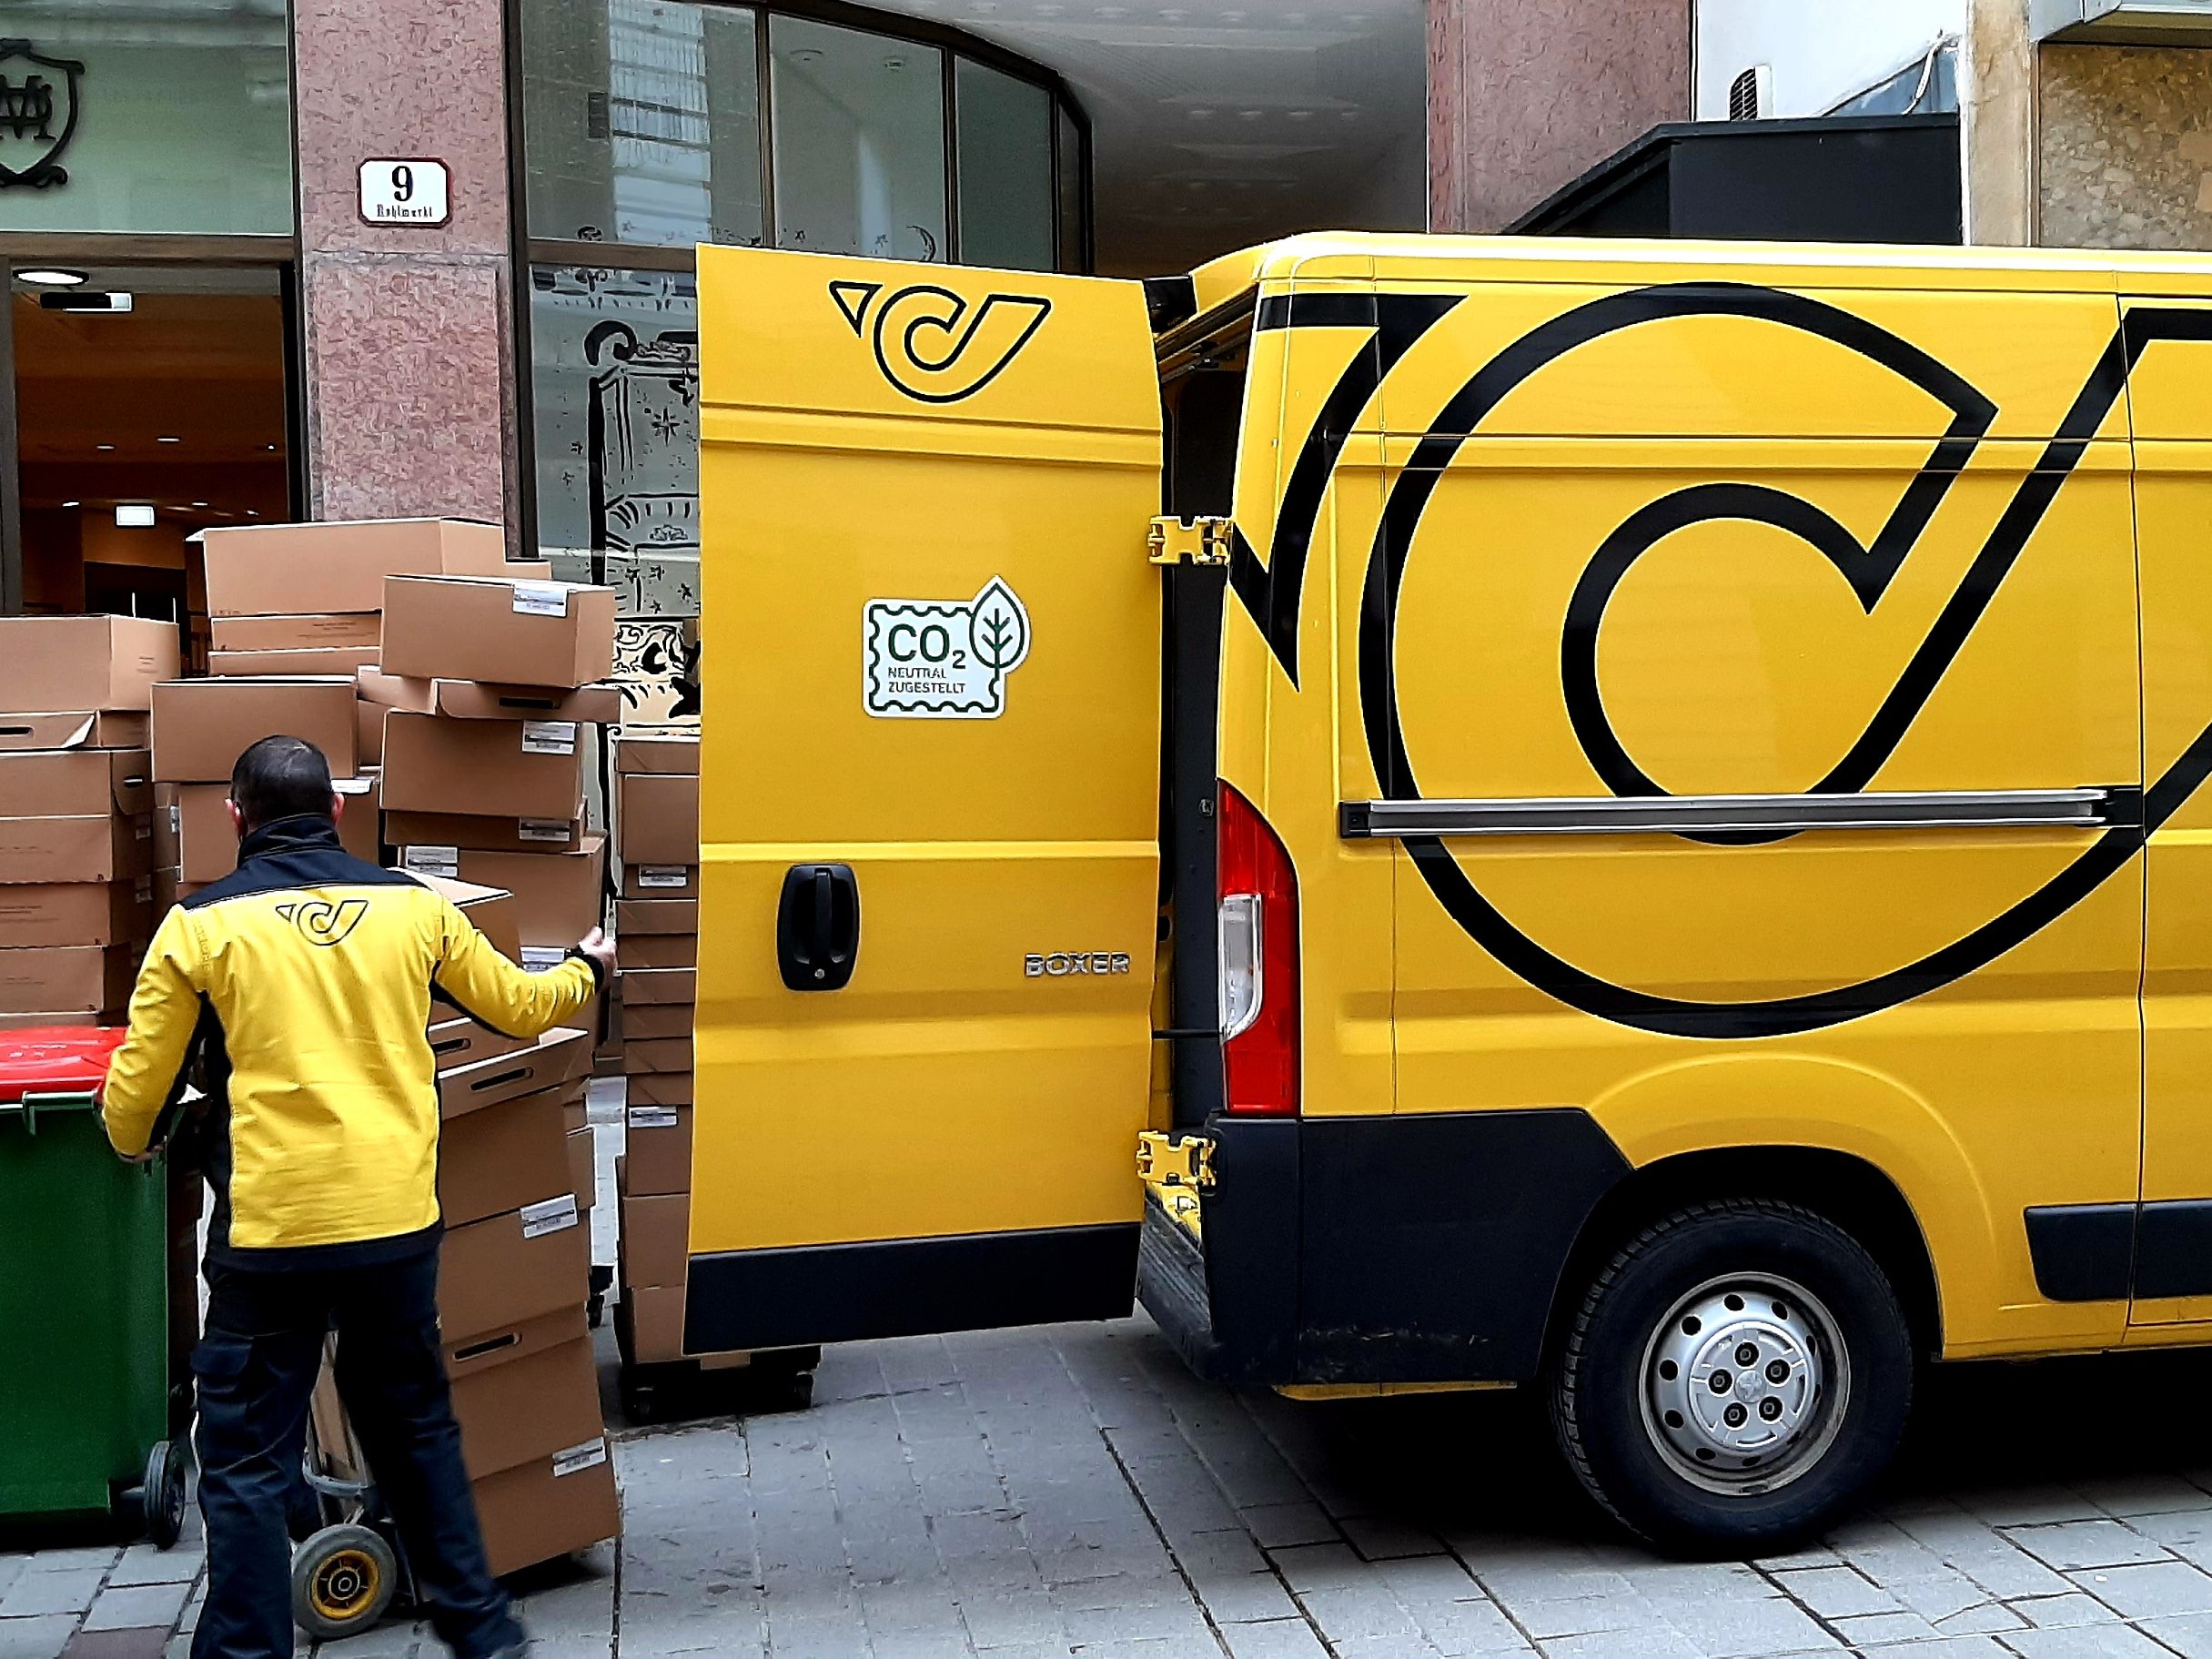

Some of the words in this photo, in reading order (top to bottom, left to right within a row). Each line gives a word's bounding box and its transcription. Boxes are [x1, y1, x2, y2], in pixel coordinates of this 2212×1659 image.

[391, 166, 413, 202] 9
[888, 666, 947, 679] NEUTRAL
[888, 682, 966, 693] ZUGESTELLT
[1025, 952, 1130, 977] BOXER
